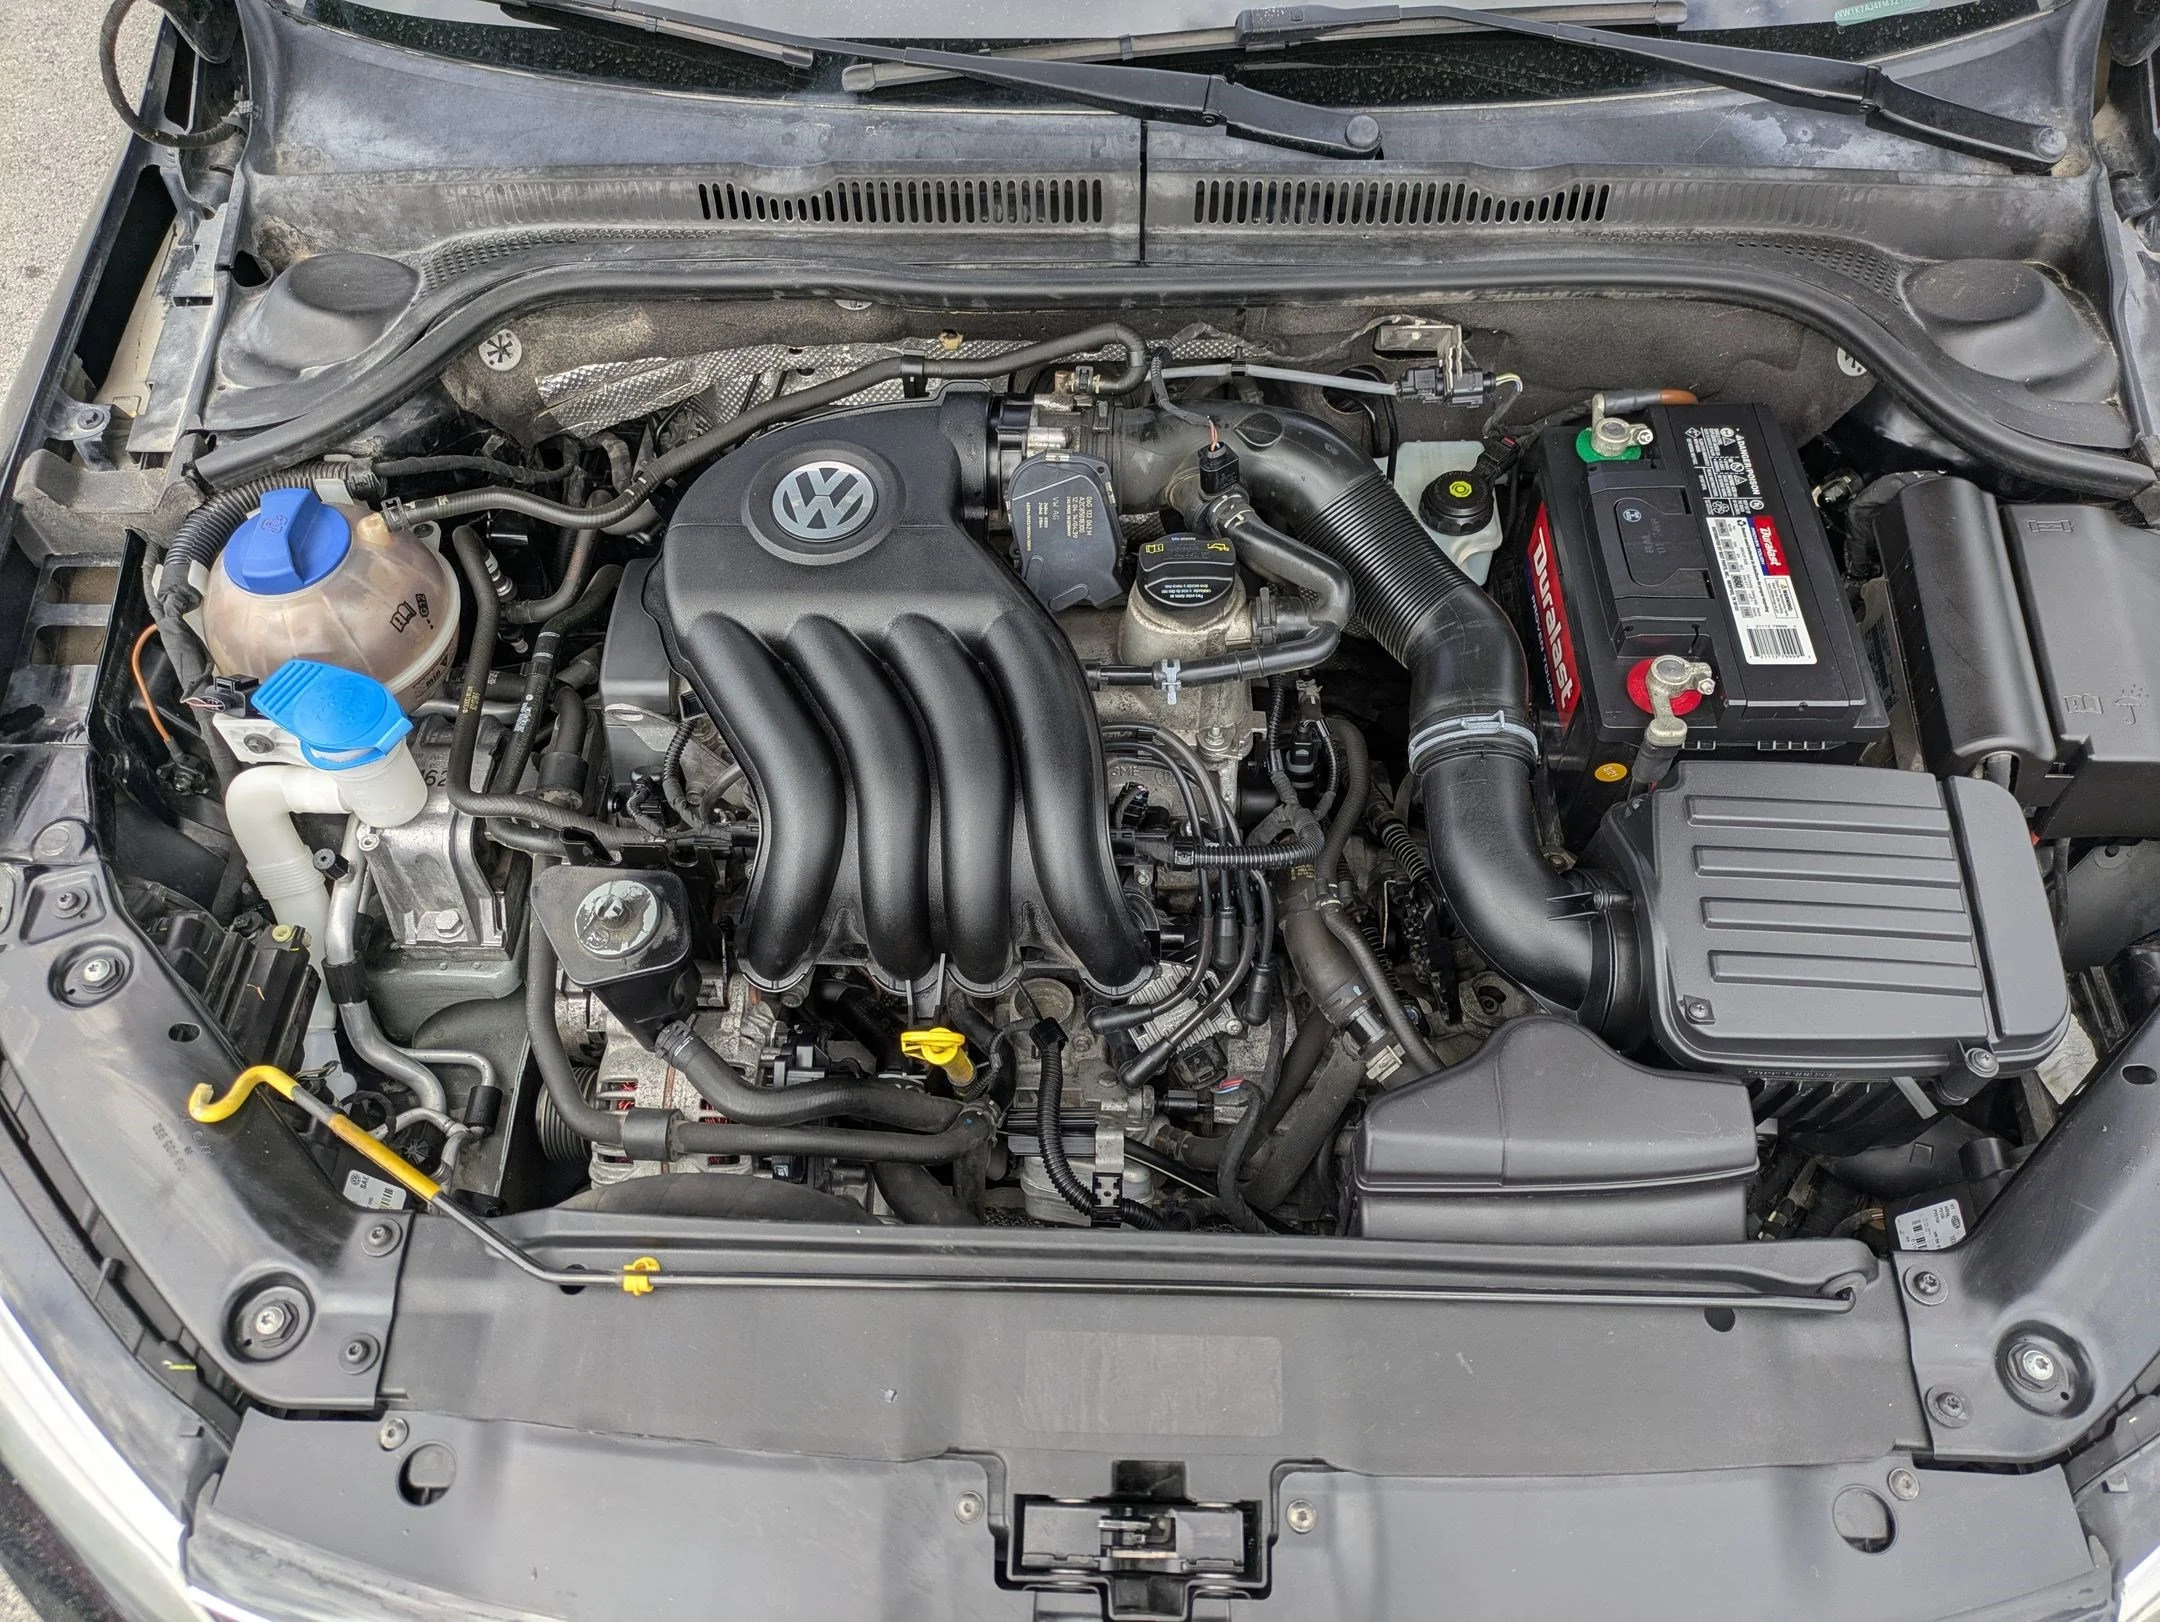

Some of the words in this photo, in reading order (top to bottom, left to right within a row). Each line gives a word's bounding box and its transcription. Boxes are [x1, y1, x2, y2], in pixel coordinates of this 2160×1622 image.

[1737, 441, 1760, 495] DANGER/POISON
[1053, 496, 1059, 507] VW
[1053, 510, 1060, 520] AG
[1760, 526, 1782, 566] Duralast
[1732, 574, 1743, 589] 680
[1533, 526, 1573, 709] Duralast
[426, 670, 440, 687] min
